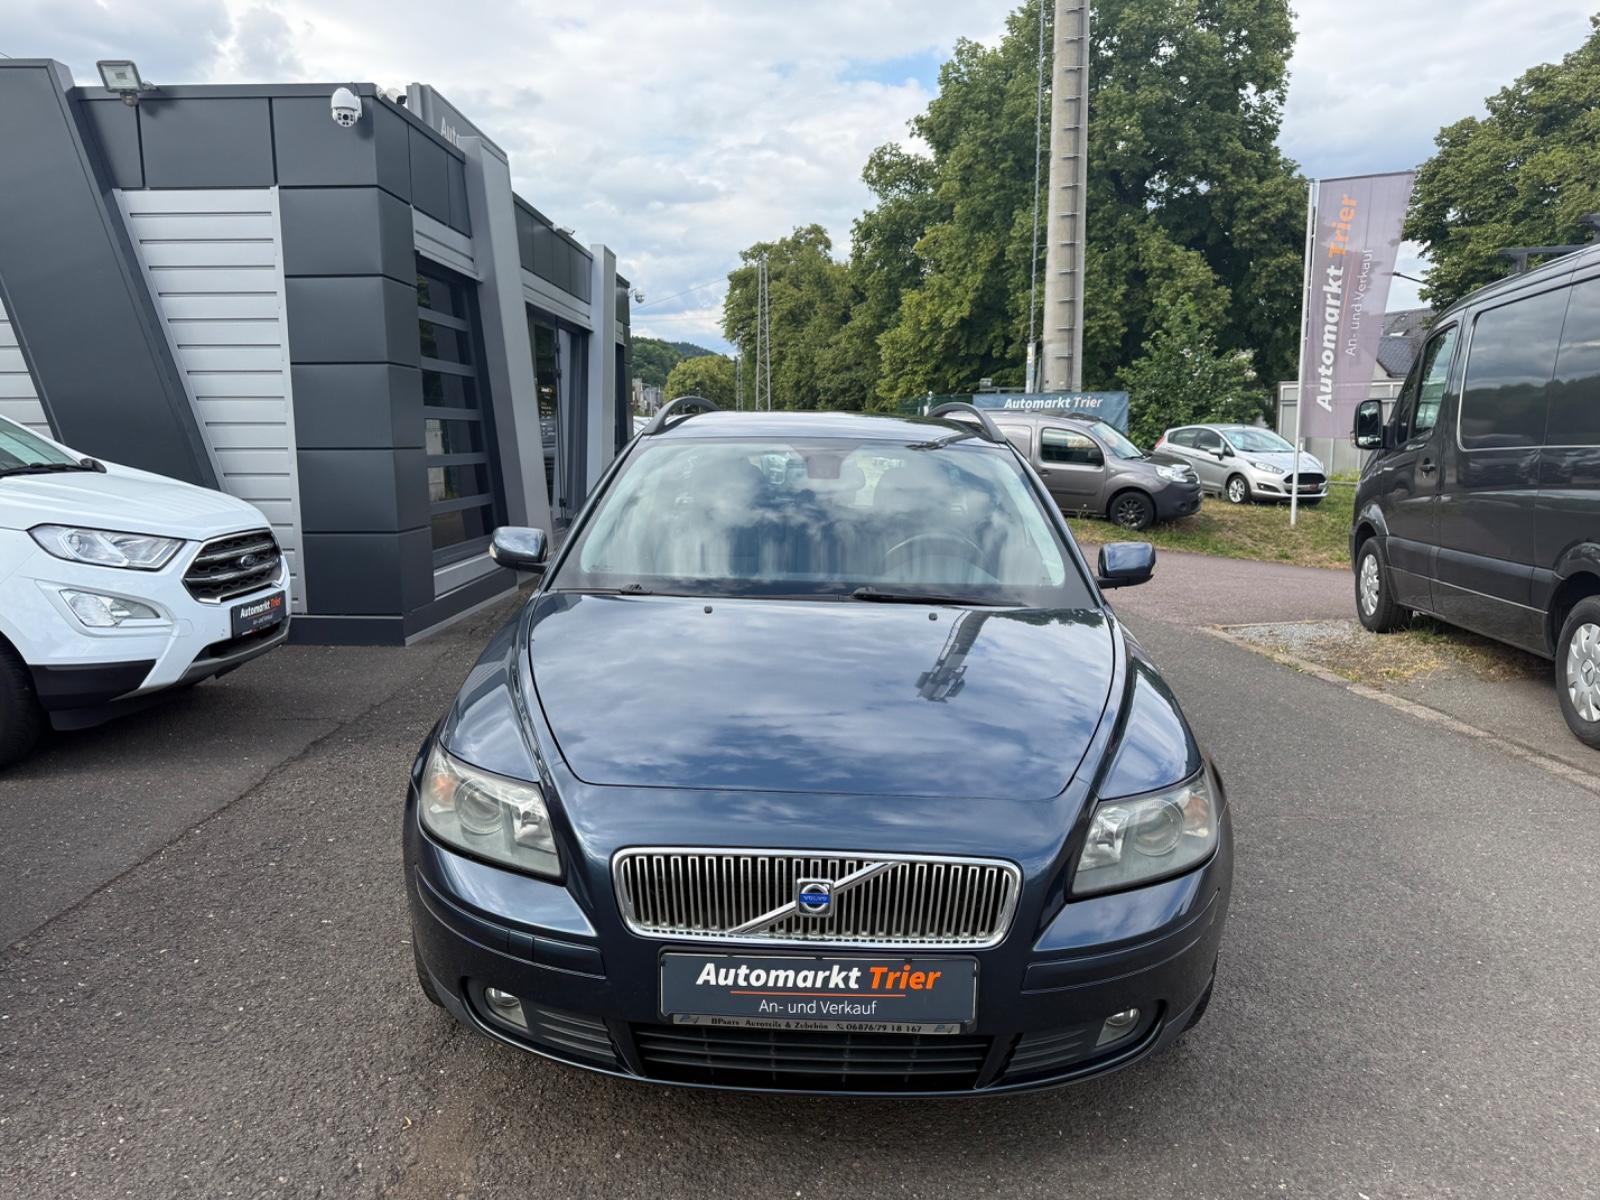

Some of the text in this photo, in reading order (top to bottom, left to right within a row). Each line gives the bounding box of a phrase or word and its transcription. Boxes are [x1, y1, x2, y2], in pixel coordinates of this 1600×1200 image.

[1316, 193, 1357, 412] Automarkt Trier
[1345, 248, 1374, 356] An- und Verkauf
[1004, 396, 1103, 409] Automarkt Trier
[240, 600, 271, 619] Automarkt
[696, 962, 941, 990] Automarkt Trier
[758, 999, 877, 1015] An- und Verkauf
[891, 1024, 902, 1032] 18
[906, 1025, 922, 1033] 167
